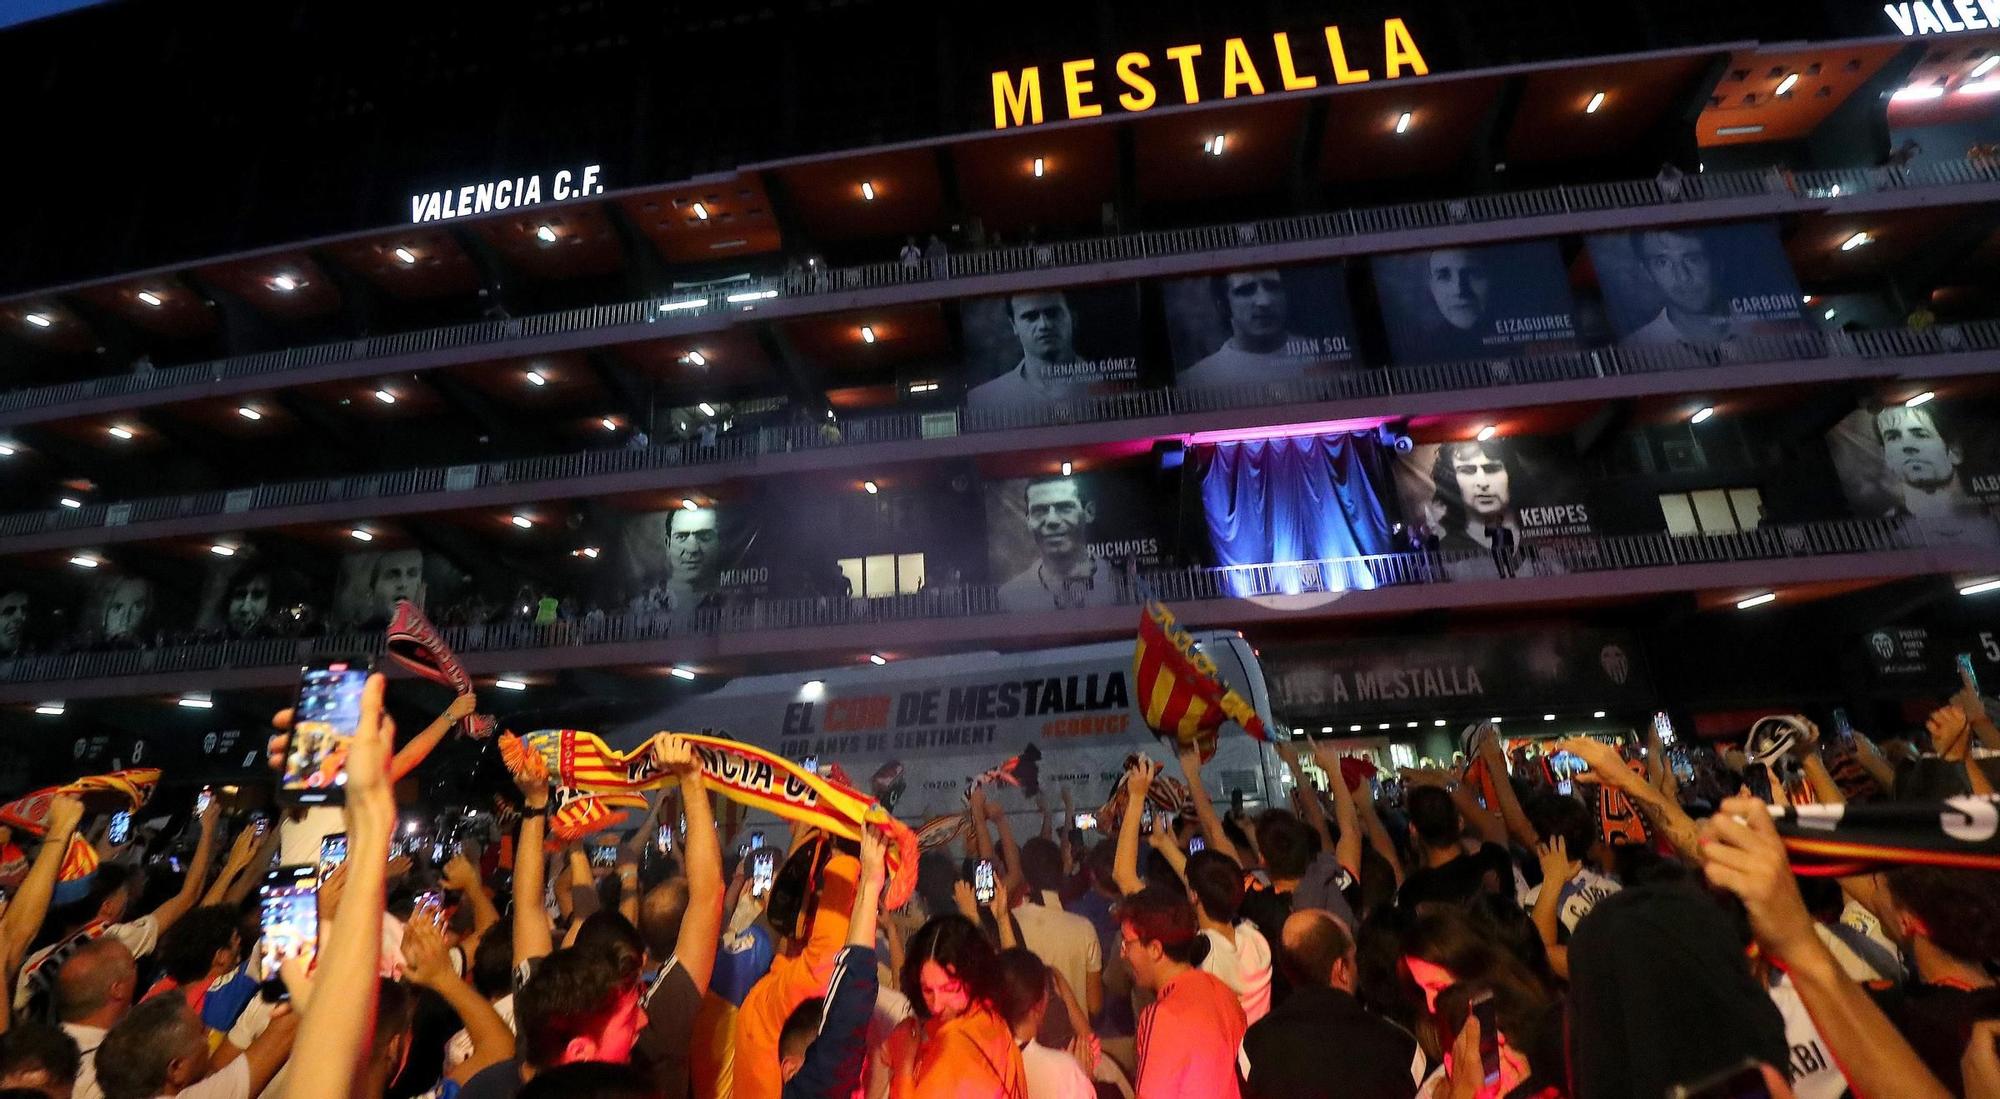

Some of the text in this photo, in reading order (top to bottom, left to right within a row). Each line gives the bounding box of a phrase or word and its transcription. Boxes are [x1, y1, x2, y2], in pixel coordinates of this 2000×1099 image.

[992, 17, 1429, 129] MESTALLA
[412, 165, 604, 223] VALENCIA C.F.
[1731, 294, 1798, 313] CARBONI
[1495, 314, 1574, 334] EIZAGUIRRE
[1323, 336, 1352, 353] SOL
[1100, 357, 1137, 372] GÓMEZ
[1520, 504, 1588, 527] KEMPES
[720, 567, 769, 587] MUNDO
[1354, 664, 1484, 702] MESTALLA
[782, 701, 816, 736] EL
[896, 688, 941, 728] DE
[945, 670, 1130, 724] MESTALLA
[814, 735, 859, 755] ANYS
[894, 723, 997, 751] SENTIMENT
[132, 740, 144, 764] 8
